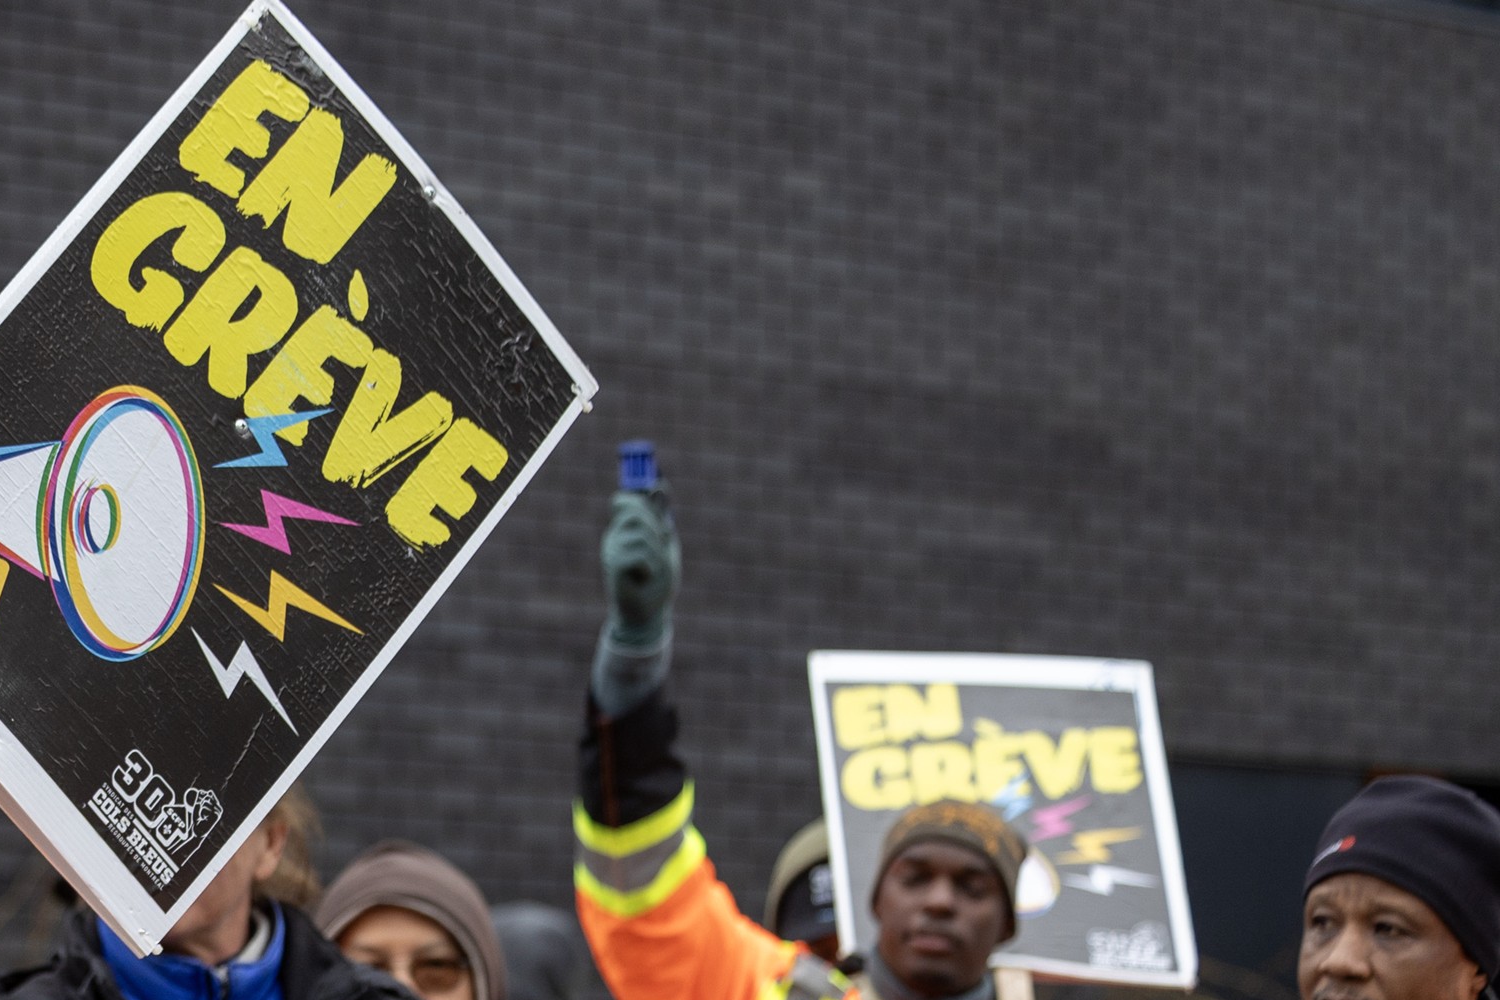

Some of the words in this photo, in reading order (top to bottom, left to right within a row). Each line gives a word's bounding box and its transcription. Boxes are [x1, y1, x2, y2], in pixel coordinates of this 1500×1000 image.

[180, 60, 396, 264] EN
[91, 191, 507, 550] GRÈVE
[832, 682, 963, 749] EN
[102, 782, 125, 808] SYNDICAT
[124, 808, 135, 820] DES
[841, 717, 1143, 811] GRÈVE
[92, 788, 131, 833] COLS
[126, 828, 174, 885] BLEUS
[166, 807, 186, 829] SCFP
